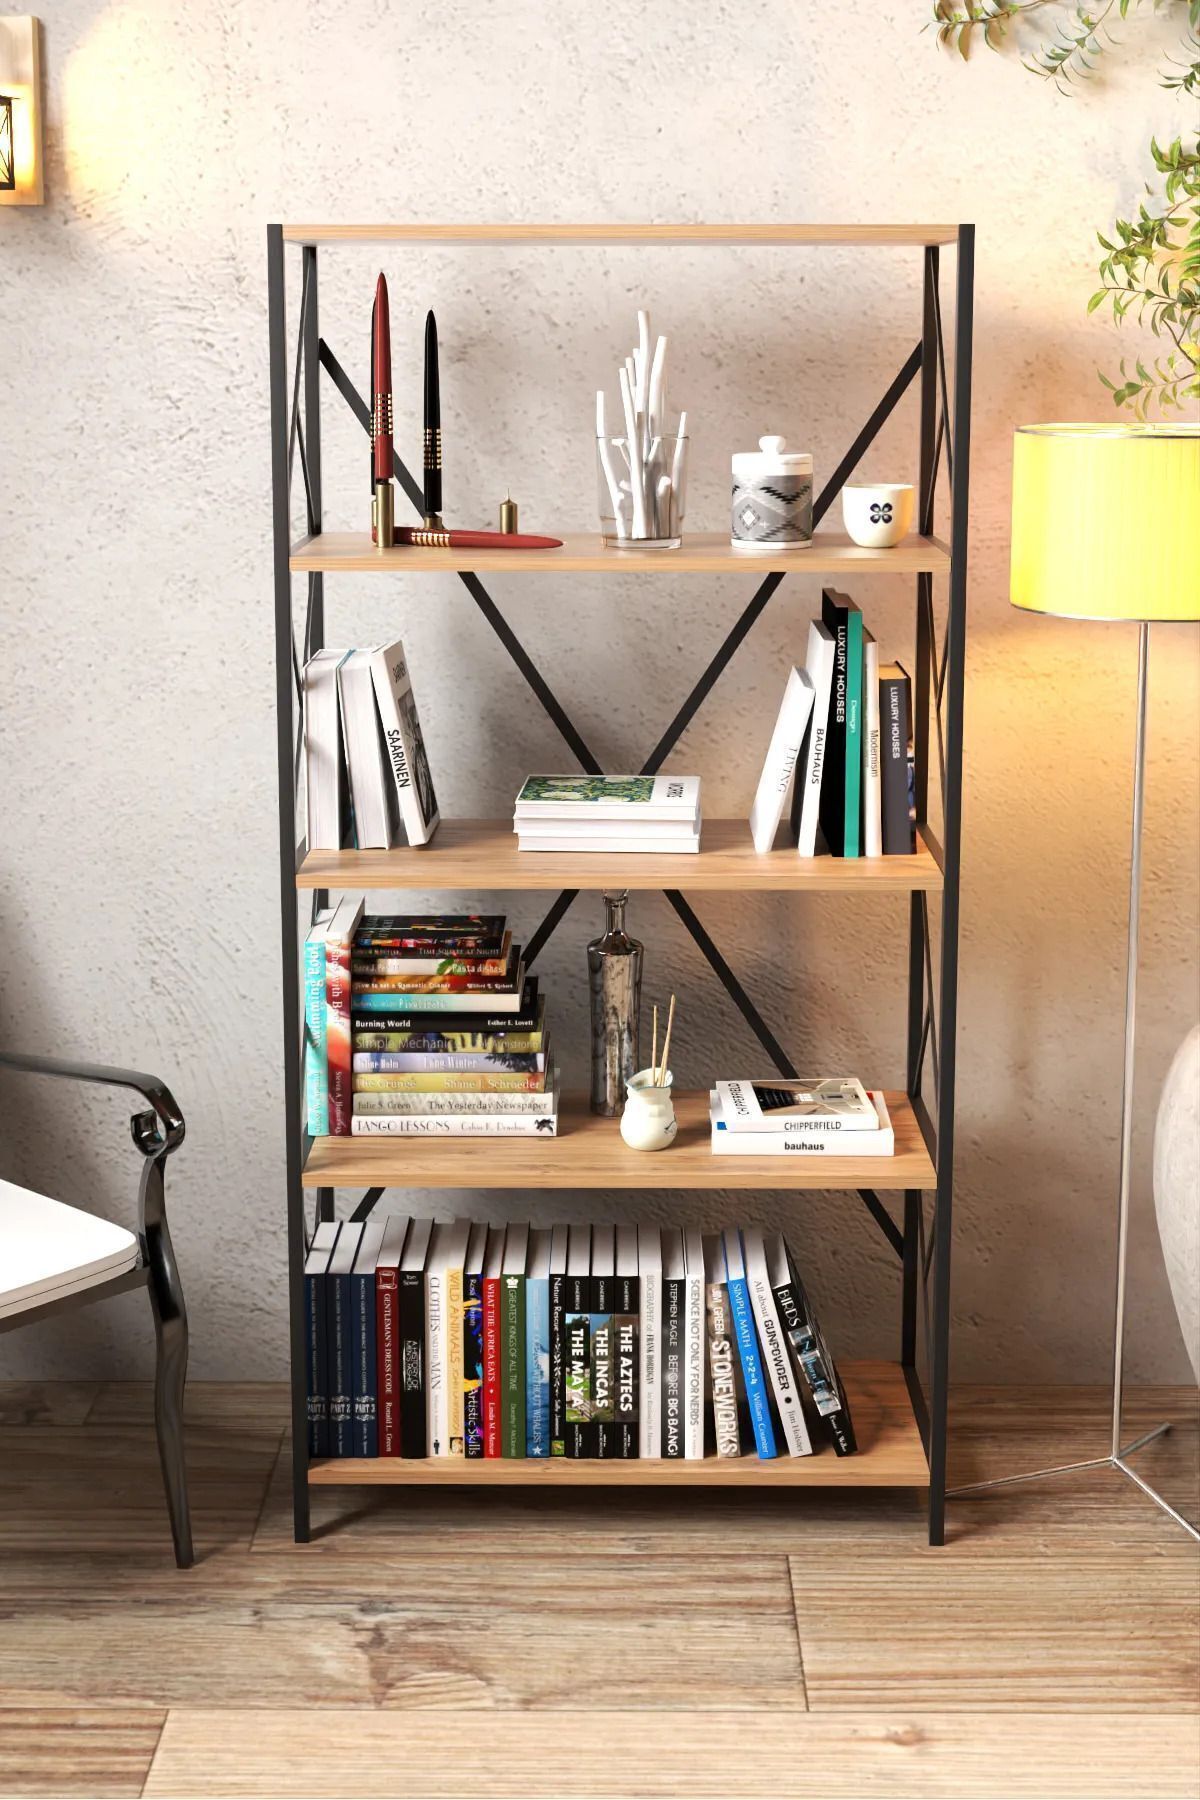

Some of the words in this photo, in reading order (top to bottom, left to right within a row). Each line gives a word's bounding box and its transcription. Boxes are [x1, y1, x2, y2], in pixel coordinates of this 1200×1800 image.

[837, 625, 846, 672] LUXURY
[836, 674, 845, 723] HOUSES
[890, 686, 899, 722] LUXURY
[869, 729, 878, 777] Modernism
[892, 723, 900, 759] HOUSES
[387, 729, 411, 788] SAARINEN
[811, 728, 825, 785] BAUHAUS
[307, 944, 320, 976] Pool
[452, 963, 475, 975] Pasta
[311, 980, 324, 1049] Swimming
[355, 1020, 386, 1029] Burning
[387, 1019, 411, 1028] World
[355, 1036, 395, 1050] Simple
[488, 1079, 541, 1089] Schroeder
[387, 1100, 411, 1109] Green
[429, 1101, 446, 1110] The
[448, 1100, 494, 1111] Yesterday
[495, 1101, 548, 1112] Newspaper
[357, 1120, 398, 1132] TANGO
[400, 1120, 450, 1132] LESSONS
[784, 1121, 842, 1131] CHIPPERFIELD
[784, 1141, 825, 1151] bauhaus
[450, 1271, 461, 1302] WILD
[487, 1283, 495, 1308] WHAT
[553, 1278, 562, 1304] Nature
[646, 1274, 655, 1323] BIOGRAPHY
[670, 1283, 678, 1318] STEPHEN
[690, 1279, 700, 1317] SCIENCE
[753, 1280, 765, 1293] All
[430, 1277, 441, 1332] CLOTHES
[487, 1310, 495, 1327] THE
[508, 1290, 517, 1323] GREATEST
[553, 1306, 562, 1332] Rescue
[732, 1283, 746, 1317] SIMPLE
[739, 1319, 752, 1348] MATH
[758, 1294, 769, 1318] about
[777, 1289, 800, 1327] BIRDS
[383, 1293, 392, 1348] GENTLEMAN'S
[450, 1305, 461, 1364] ANIMALS
[670, 1319, 678, 1347] EAGLE
[690, 1318, 700, 1341] NOT
[713, 1306, 725, 1335] GREEN
[509, 1326, 517, 1348] KINGS
[572, 1328, 584, 1356] THE
[596, 1328, 609, 1356] THE
[620, 1324, 633, 1352] THE
[384, 1348, 392, 1371] DRESS
[509, 1348, 517, 1358] OF
[509, 1360, 517, 1373] ALL
[690, 1342, 700, 1372] ONLY
[764, 1319, 790, 1391] GUNPOWDER
[385, 1373, 393, 1394] CODE
[431, 1361, 441, 1390] MAN
[488, 1361, 496, 1382] EATS
[509, 1375, 517, 1391] TIME
[572, 1360, 584, 1408] MAYA
[596, 1360, 609, 1408] INCAS
[620, 1356, 633, 1412] AZTECS
[668, 1353, 679, 1396] BEFORE
[690, 1373, 700, 1394] FOR
[745, 1355, 758, 1385] 2+2=4
[330, 1403, 345, 1414] PART
[346, 1403, 351, 1414] 2
[355, 1403, 370, 1414] PART
[370, 1403, 376, 1414] 3
[467, 1389, 479, 1427] Artistic
[668, 1398, 678, 1417] BIG
[690, 1395, 700, 1426] NERDS
[711, 1340, 738, 1455] STONEWORKS
[752, 1392, 765, 1422] William
[385, 1402, 393, 1424] Ronald
[533, 1408, 541, 1443] WHALES
[468, 1428, 481, 1456] Skills
[667, 1418, 678, 1456] BANG!
[757, 1423, 769, 1454] Counter
